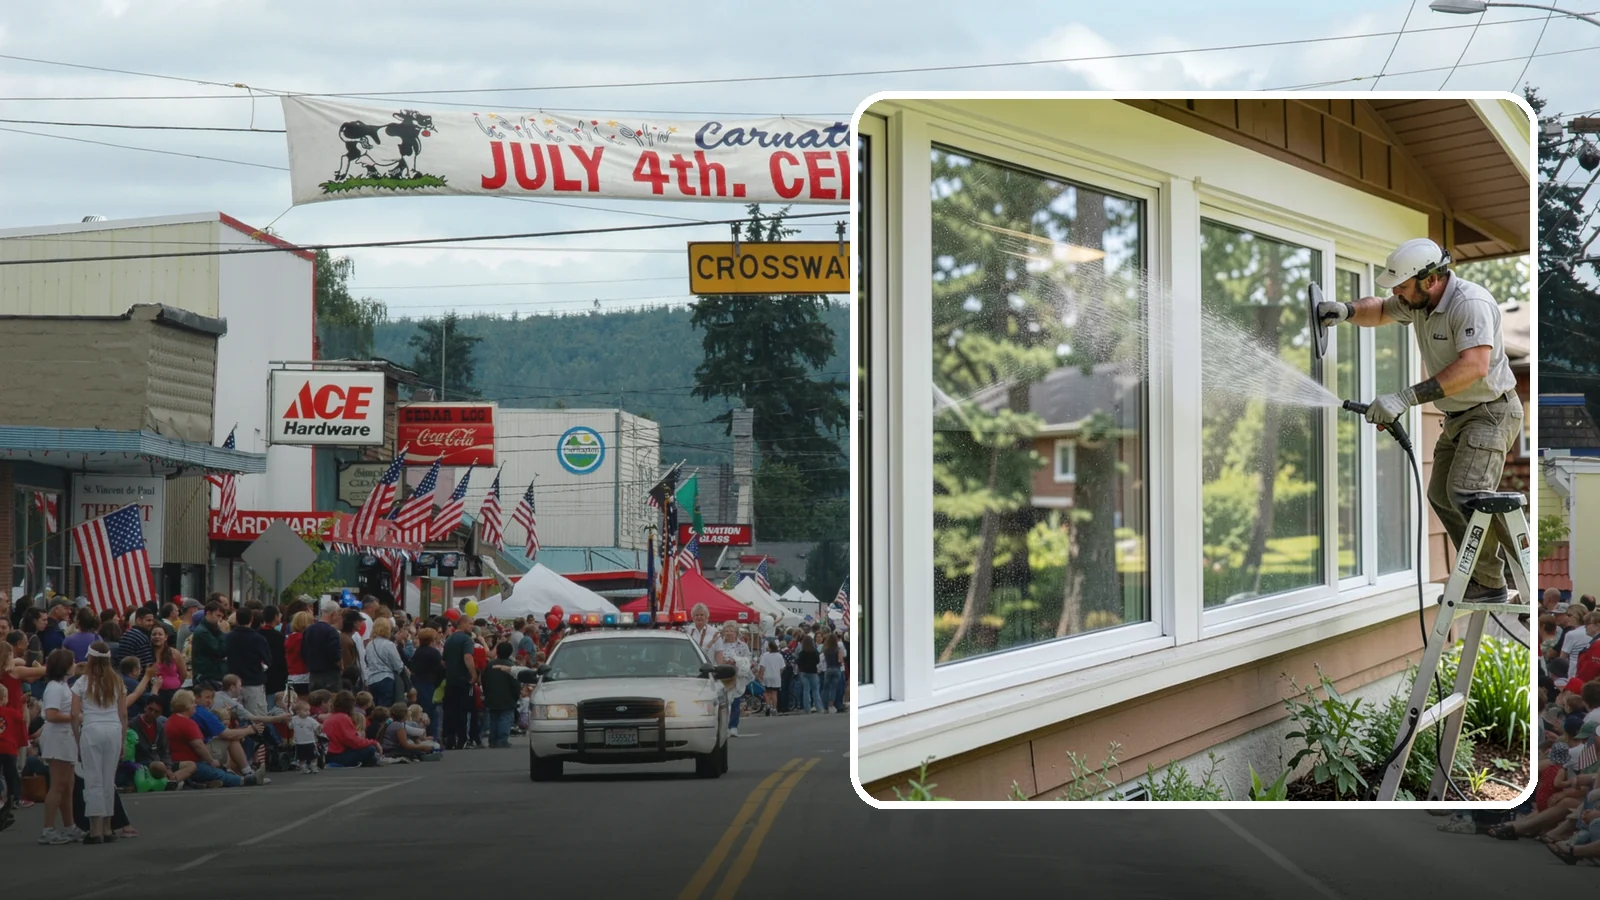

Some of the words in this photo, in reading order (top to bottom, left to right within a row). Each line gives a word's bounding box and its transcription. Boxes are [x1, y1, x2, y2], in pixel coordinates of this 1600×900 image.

[481, 141, 605, 192] JULY
[632, 150, 746, 197] 4th.
[697, 254, 850, 280] CROSSWA
[283, 380, 373, 420] ACE
[406, 409, 453, 422] CEDAR
[461, 409, 485, 421] LOG
[283, 421, 371, 436] Hardware
[416, 428, 477, 447] Coca-Cola
[83, 485, 93, 494] St.
[96, 485, 124, 494] Vincent
[126, 486, 135, 494] de
[137, 486, 155, 495] Paul
[688, 526, 741, 535] CRNATION
[699, 535, 730, 543] GLASS
